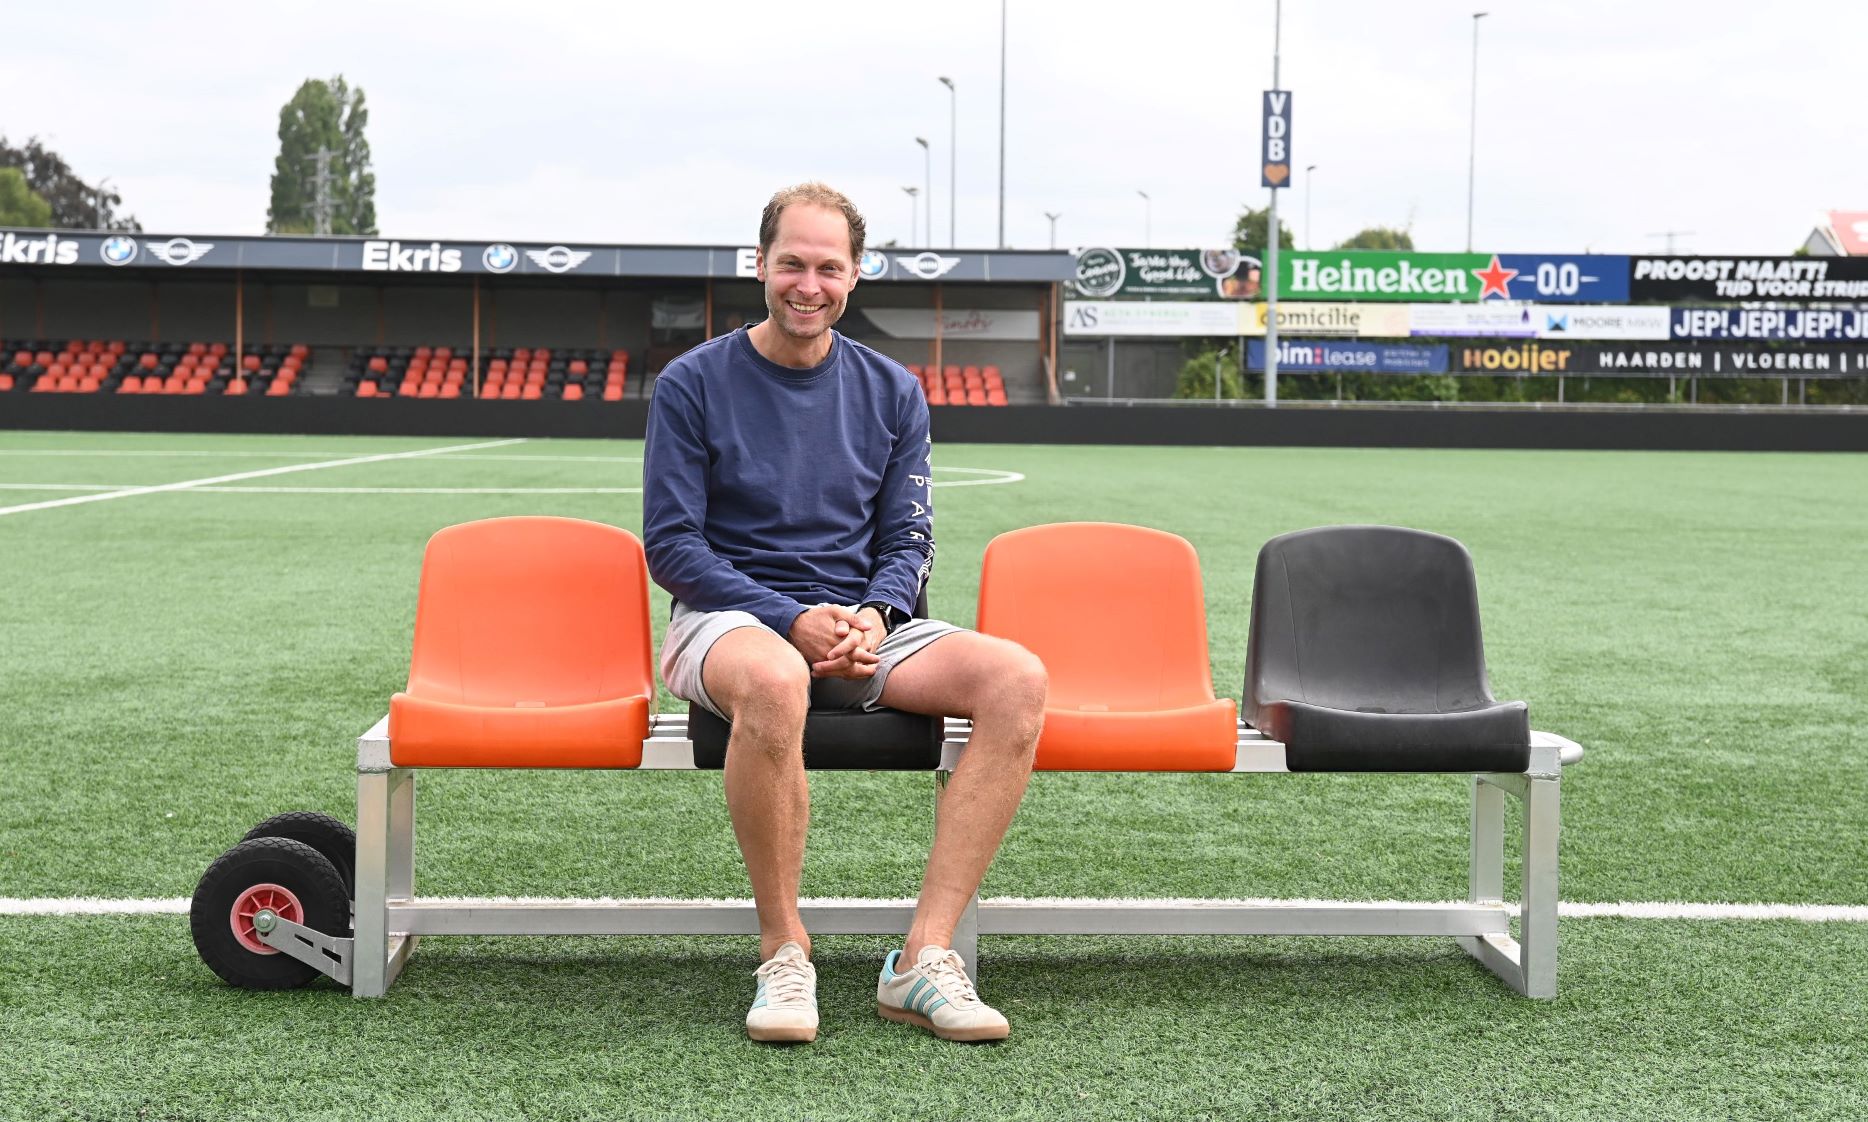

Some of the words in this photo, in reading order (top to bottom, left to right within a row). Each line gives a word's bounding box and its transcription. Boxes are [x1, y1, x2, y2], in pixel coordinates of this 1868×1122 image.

[1267, 92, 1287, 162] VDB
[0, 232, 79, 265] kris
[362, 241, 462, 272] Ekris
[1290, 259, 1468, 294] Heineken
[1536, 262, 1580, 295] 0.0
[1634, 259, 1734, 281] PROOST
[1735, 260, 1828, 281] MAATT!
[1716, 280, 1753, 298] TIJD
[1756, 280, 1811, 297] VOOR
[1674, 309, 1729, 337] JEP!
[1731, 310, 1786, 338] JEP!
[1787, 311, 1842, 339] JEP!
[1463, 344, 1571, 374] Hooijer
[1600, 352, 1701, 369] HAARDEN
[1732, 352, 1830, 370] VLOEREN
